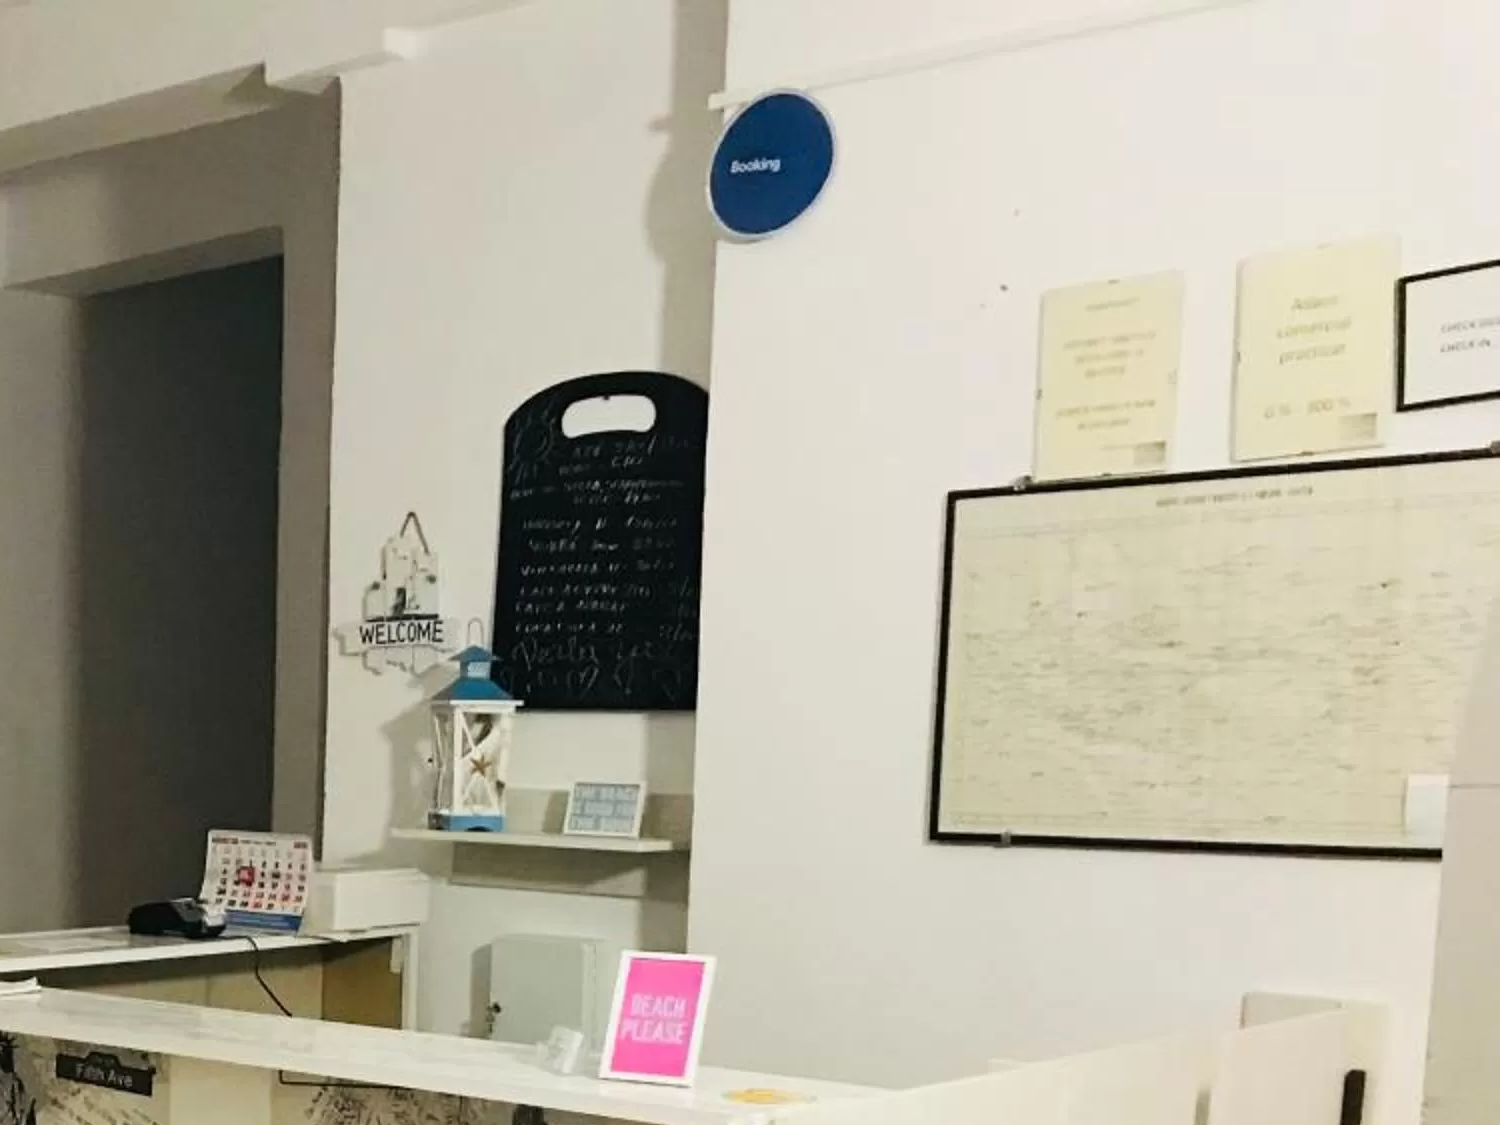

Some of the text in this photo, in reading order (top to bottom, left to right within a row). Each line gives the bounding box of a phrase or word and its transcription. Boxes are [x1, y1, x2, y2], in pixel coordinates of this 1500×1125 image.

[731, 156, 781, 174] Booking
[359, 620, 444, 644] WELCOME
[630, 993, 687, 1019] BEACH
[621, 1018, 688, 1045] PLEASE
[107, 1069, 133, 1088] Ave
